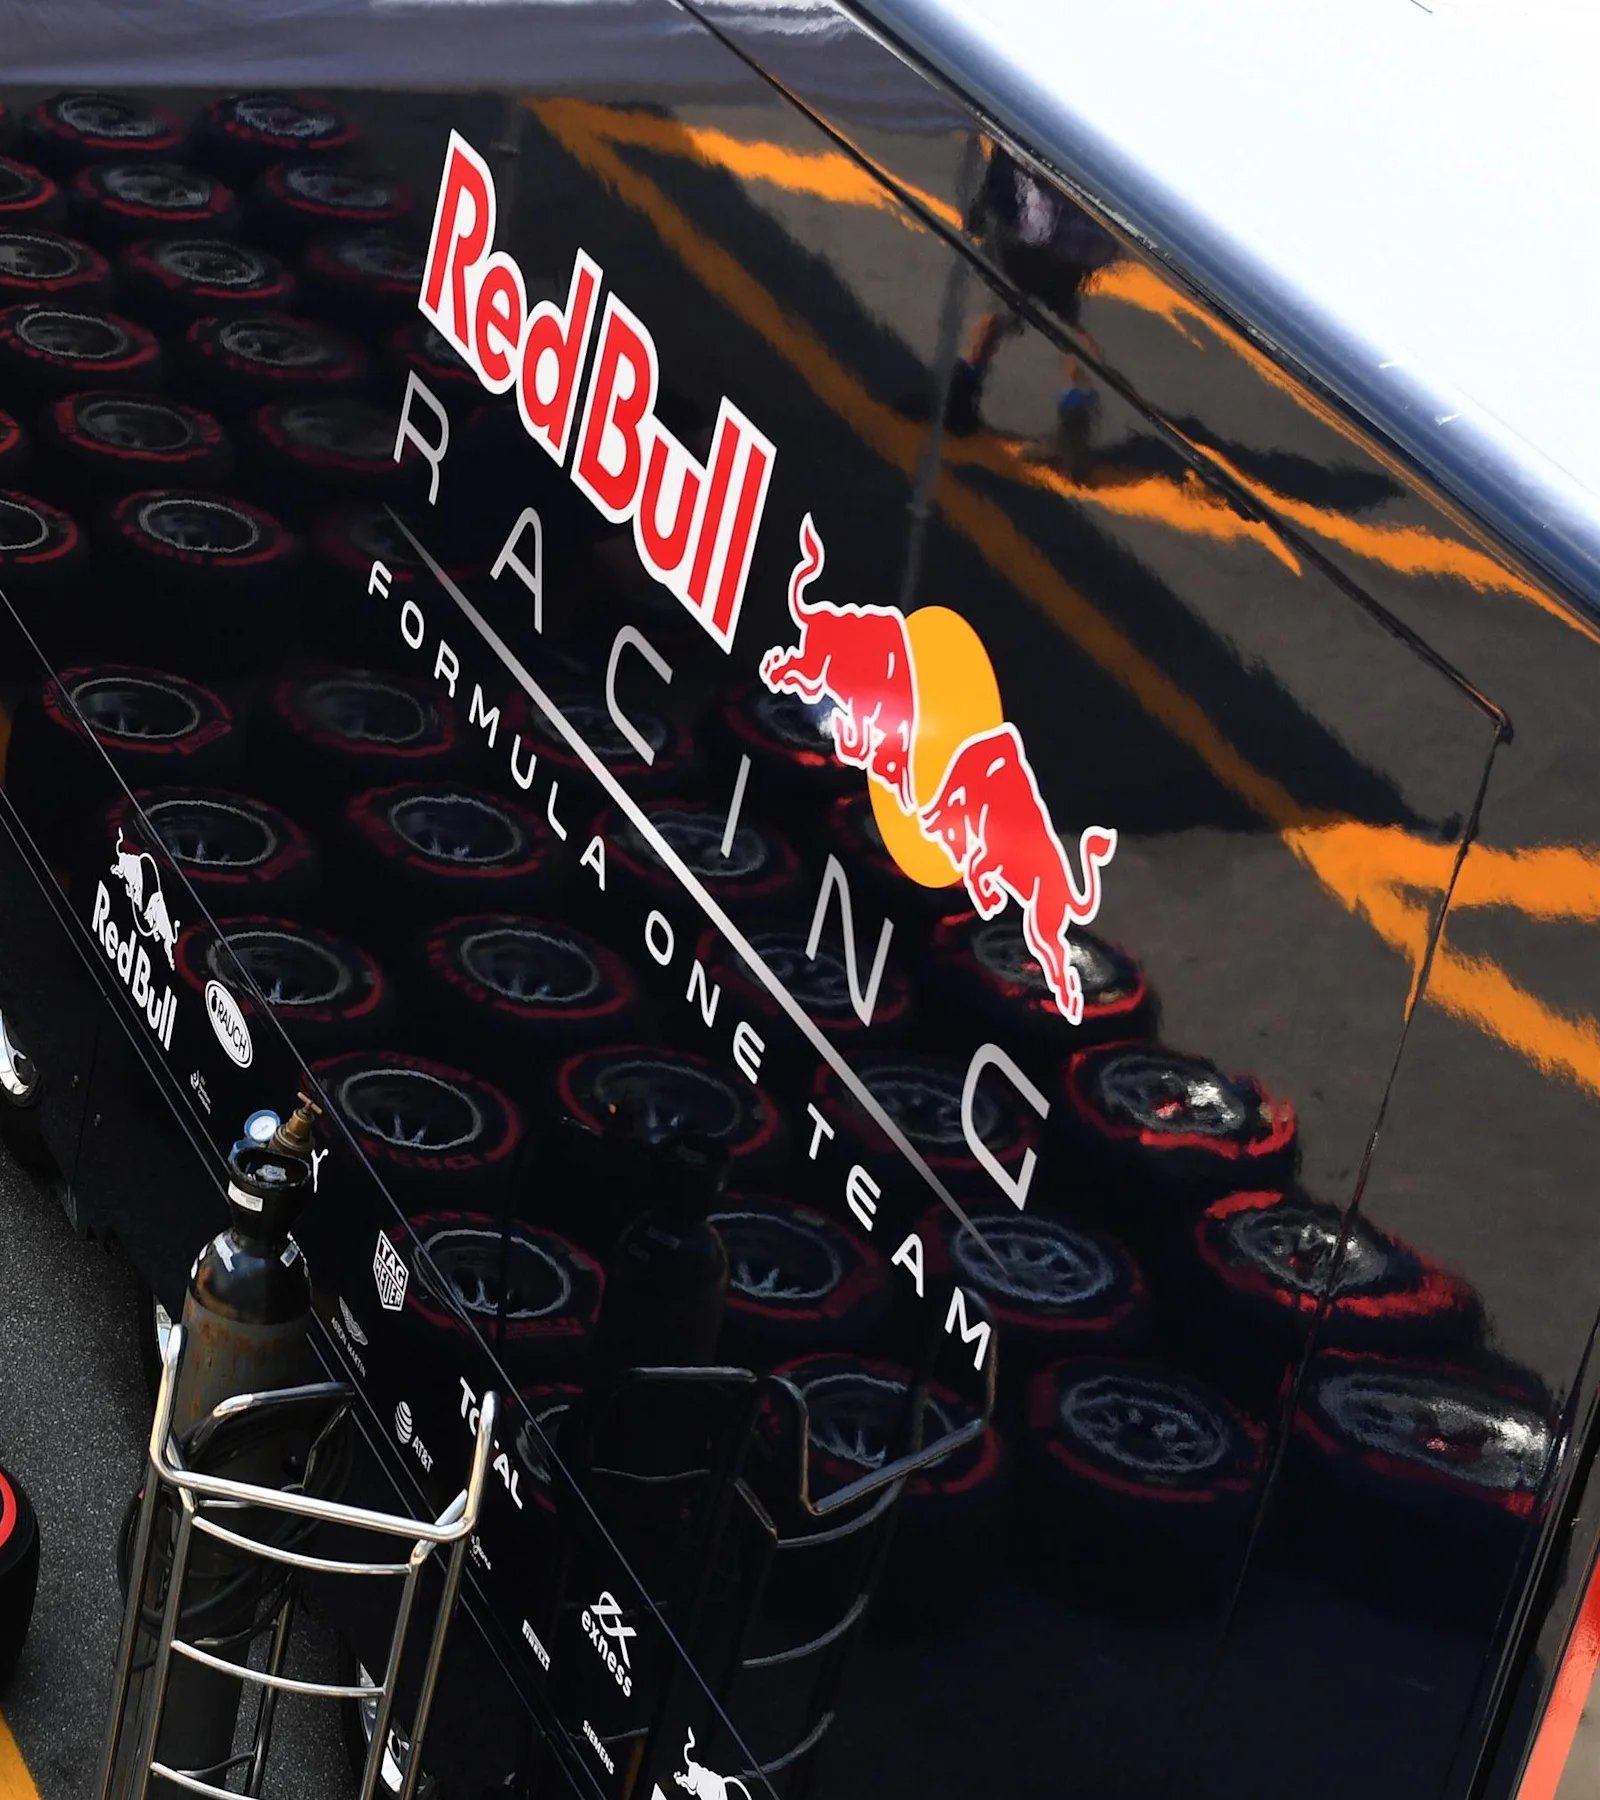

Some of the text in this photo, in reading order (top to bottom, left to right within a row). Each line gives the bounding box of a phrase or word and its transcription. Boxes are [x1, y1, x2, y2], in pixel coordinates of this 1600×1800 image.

[394, 370, 1051, 1210] RACING
[367, 561, 992, 1371] FORMULA ONE TEAM
[216, 1002, 248, 1057] RAUCH
[376, 1258, 401, 1306] HEUER
[380, 1238, 405, 1288] TAG
[331, 1317, 366, 1378] ASTON MARTIN
[412, 1435, 434, 1473] AT&T
[460, 1376, 523, 1509] TOAL
[522, 1619, 550, 1671] PIRELLI
[581, 1610, 633, 1697] exness
[582, 1720, 615, 1775] SIEMENS
